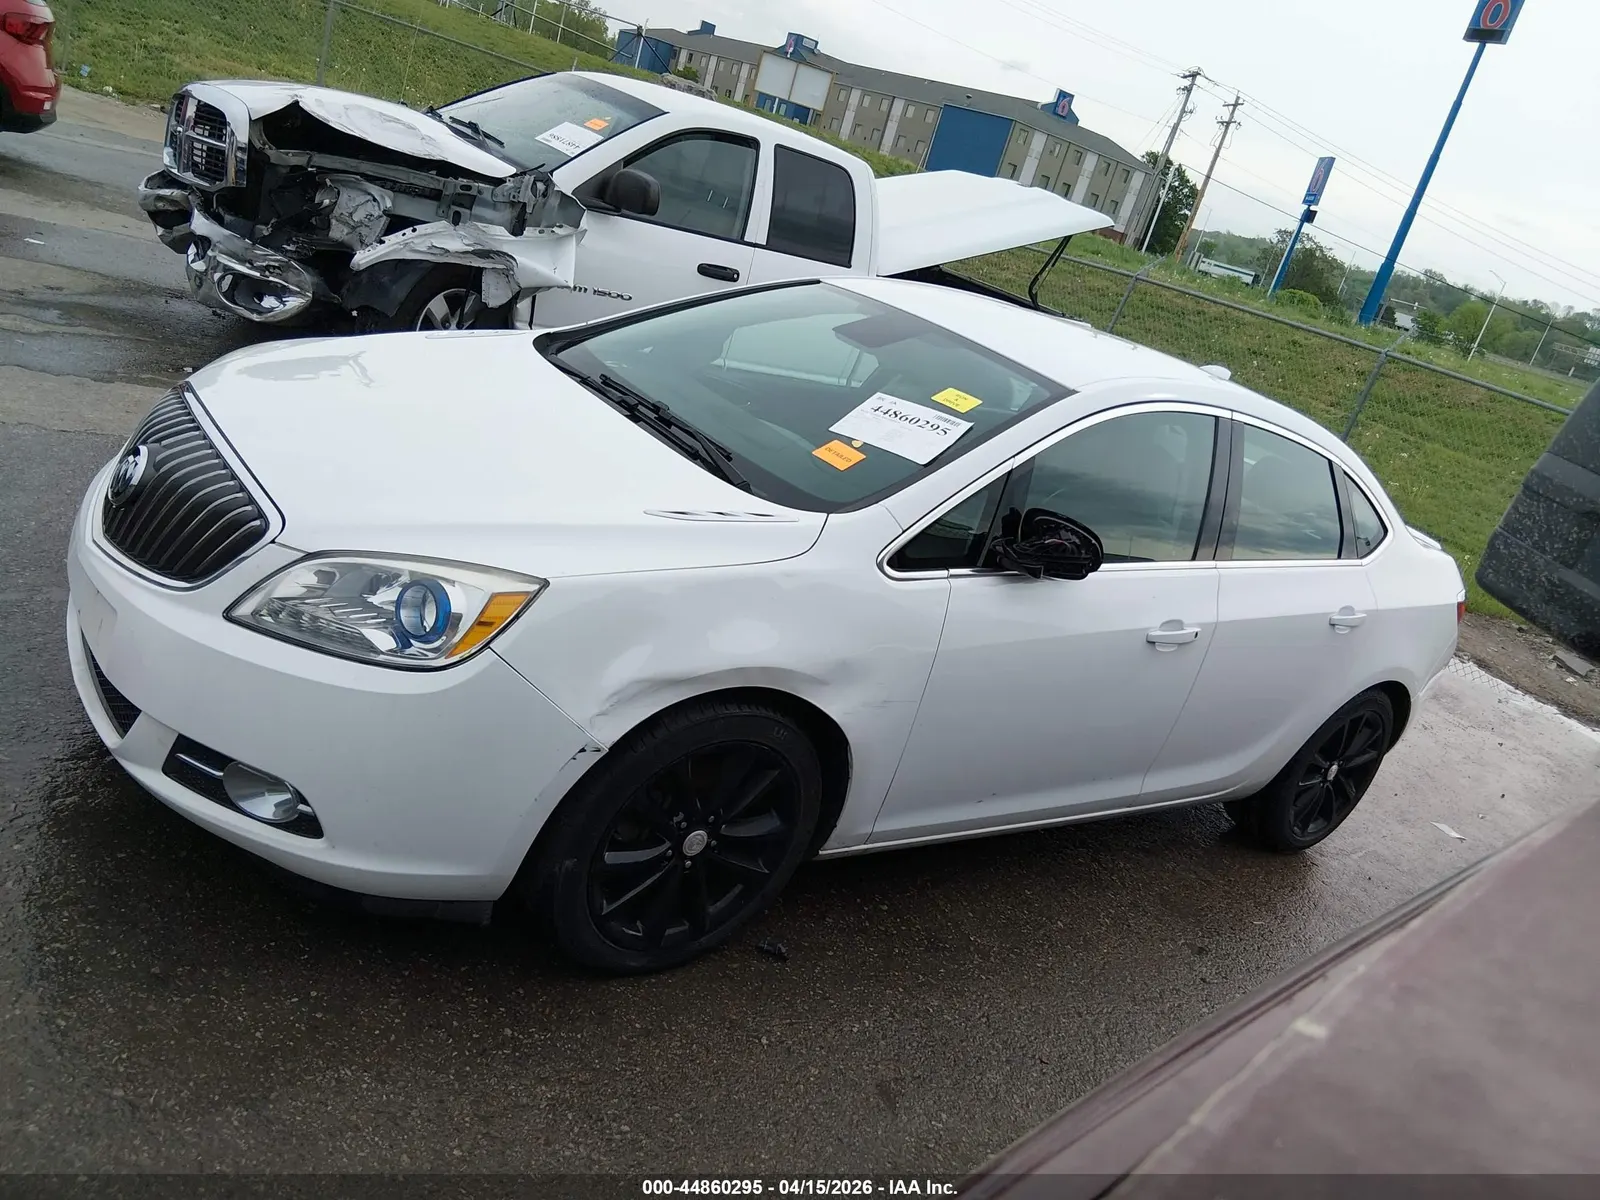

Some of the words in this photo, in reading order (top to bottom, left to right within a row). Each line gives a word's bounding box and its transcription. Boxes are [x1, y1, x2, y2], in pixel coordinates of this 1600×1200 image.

[592, 286, 633, 301] 1500
[870, 404, 952, 437] 44860295
[824, 446, 853, 463] DETAILED
